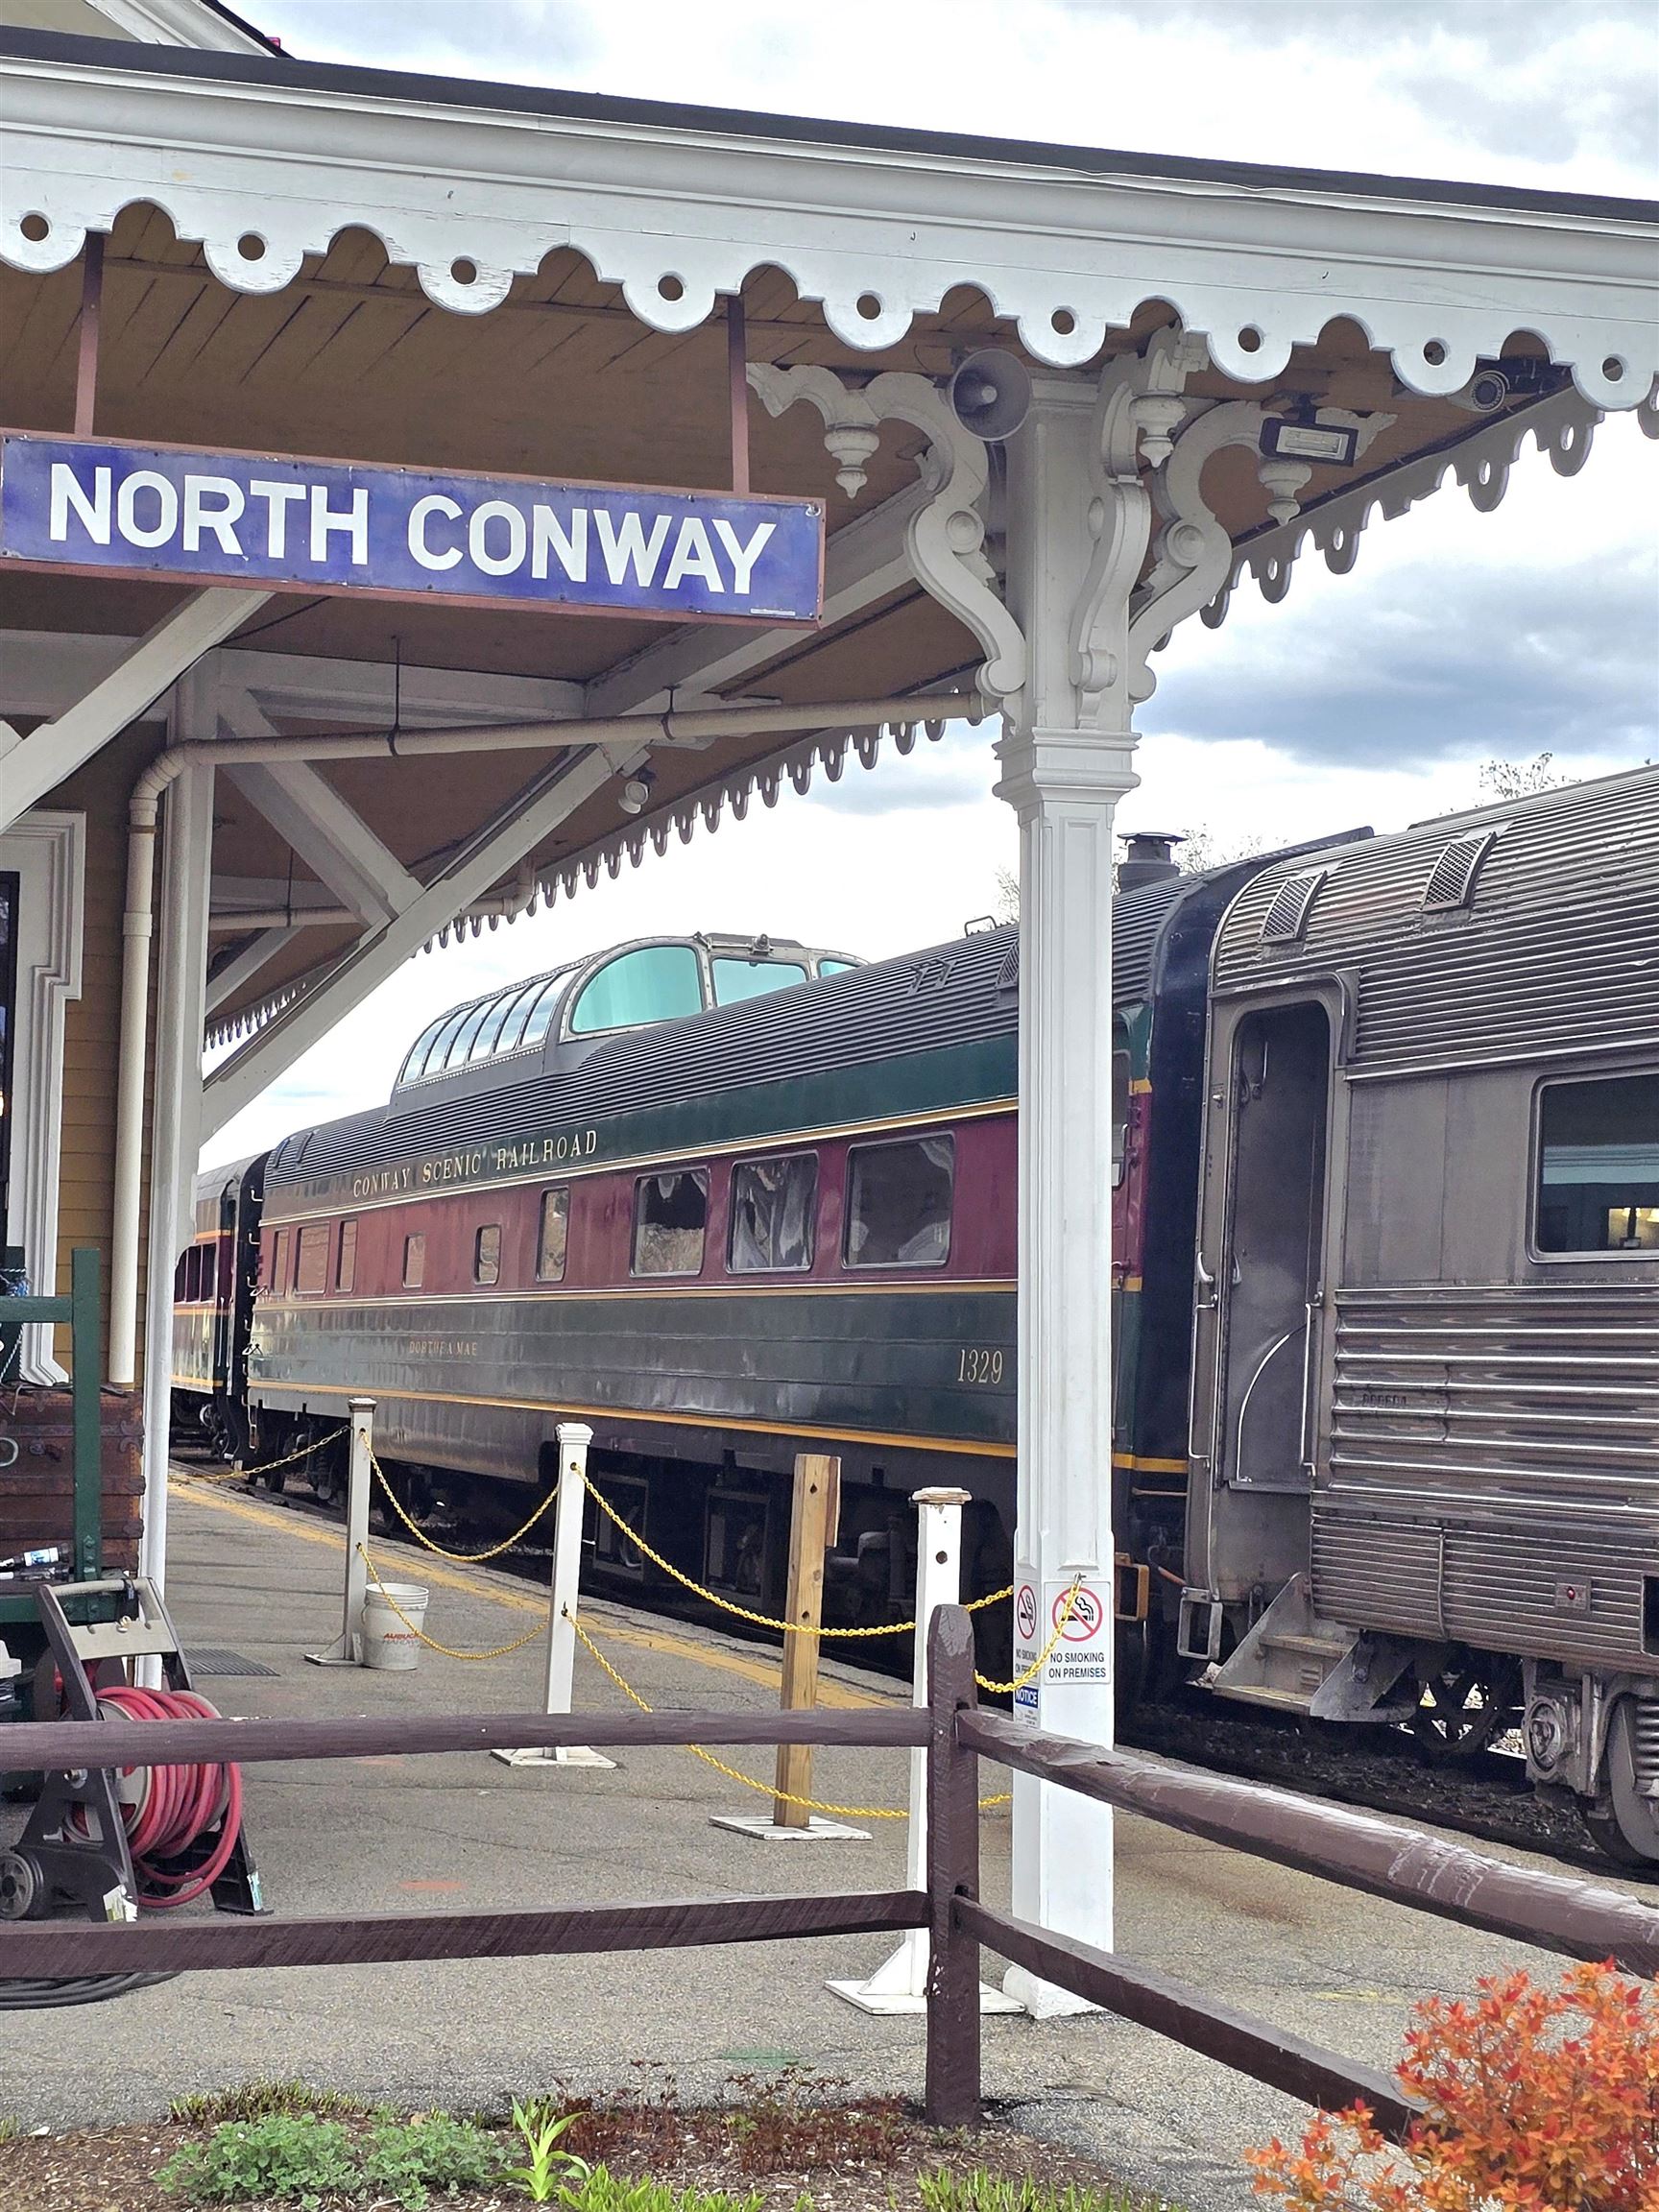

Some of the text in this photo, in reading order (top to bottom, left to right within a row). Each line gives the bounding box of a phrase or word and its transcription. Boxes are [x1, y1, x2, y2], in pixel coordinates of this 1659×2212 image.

[50, 463, 776, 594] NORTH CONWAY
[352, 1129, 597, 1198] CONWAY SCENIC RAILROAD
[957, 1349, 1003, 1384] 1329
[1050, 1652, 1104, 1664] NO SMOKING
[1048, 1668, 1062, 1678] ON
[1064, 1667, 1106, 1679] PREMISES
[1016, 1688, 1038, 1705] NOTICE
